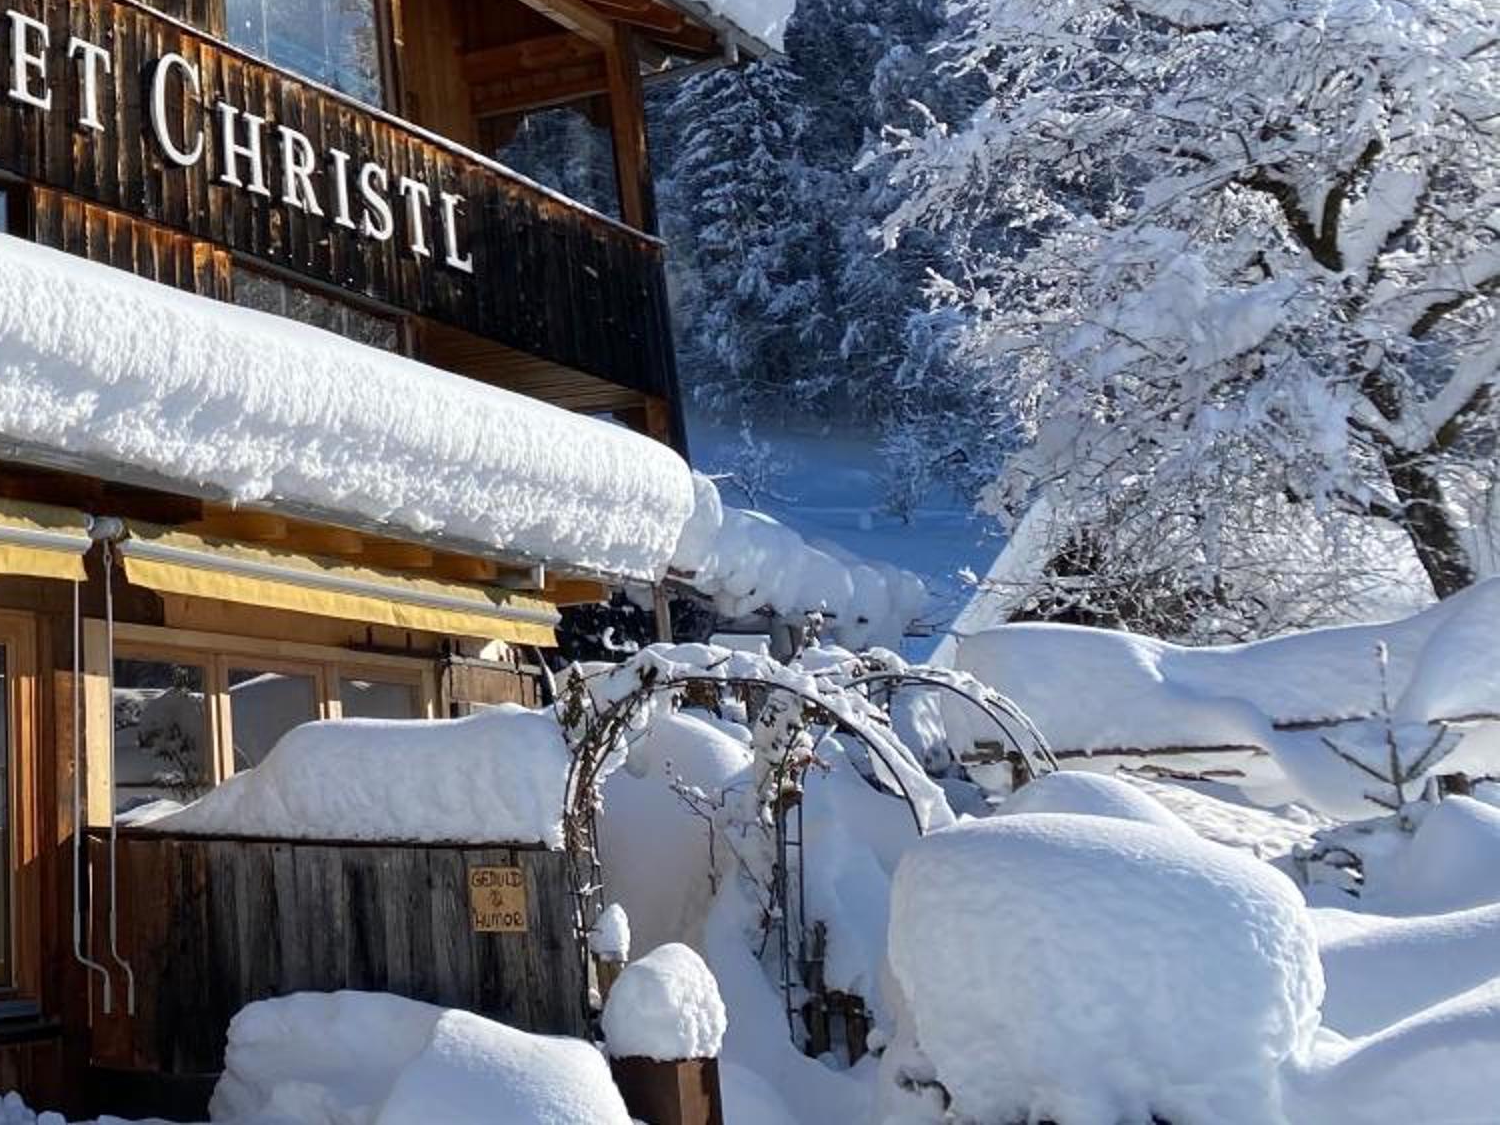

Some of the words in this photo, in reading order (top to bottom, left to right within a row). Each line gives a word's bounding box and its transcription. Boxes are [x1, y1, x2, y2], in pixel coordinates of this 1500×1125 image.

[150, 52, 474, 274] CHRISTL
[471, 870, 522, 888] GEDULD
[475, 911, 524, 928] HUMOR
